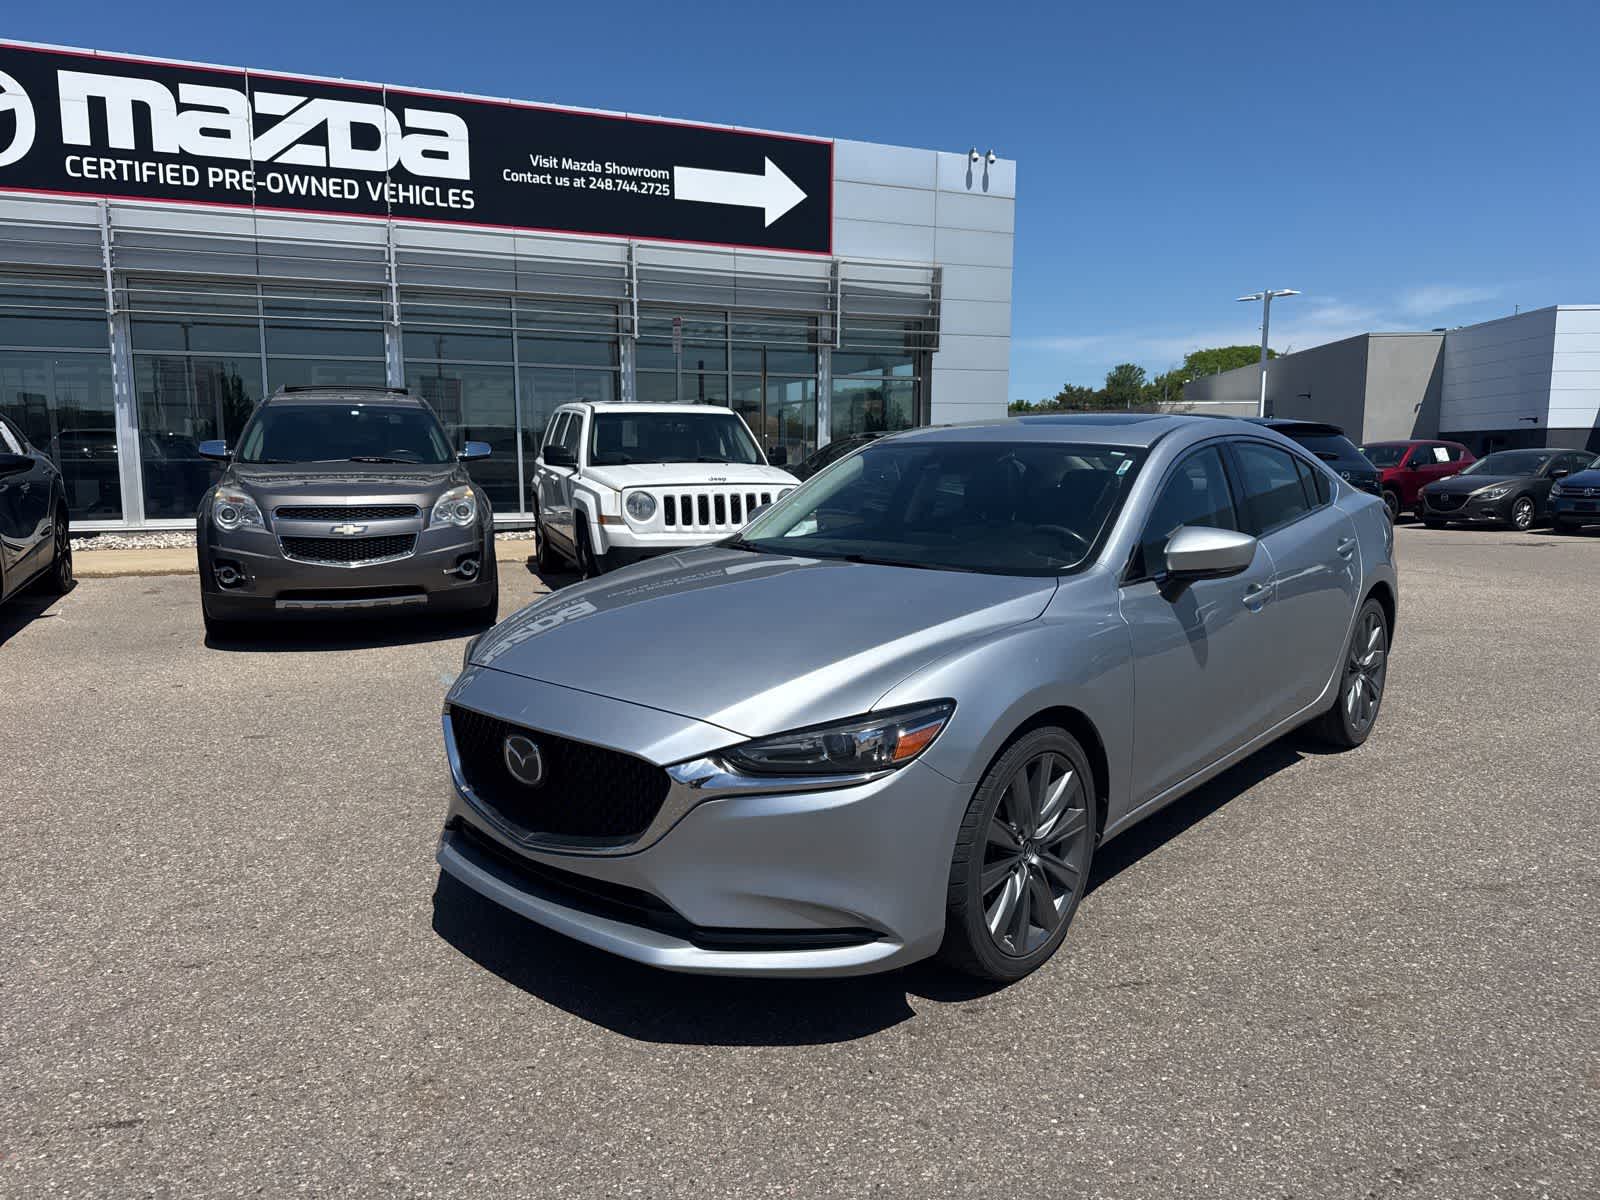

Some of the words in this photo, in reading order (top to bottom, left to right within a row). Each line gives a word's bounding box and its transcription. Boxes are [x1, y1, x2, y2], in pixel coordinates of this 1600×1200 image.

[529, 154, 558, 169] Visit
[562, 157, 602, 173] Mazda
[605, 162, 669, 179] Showroom
[65, 155, 200, 187] CERTIFIED
[208, 166, 360, 200] PRE-OWNED
[366, 181, 475, 210] VEHICLES
[503, 169, 552, 185] Contact
[555, 176, 570, 187] us
[573, 176, 586, 188] at
[589, 177, 670, 195] 248.744.2725
